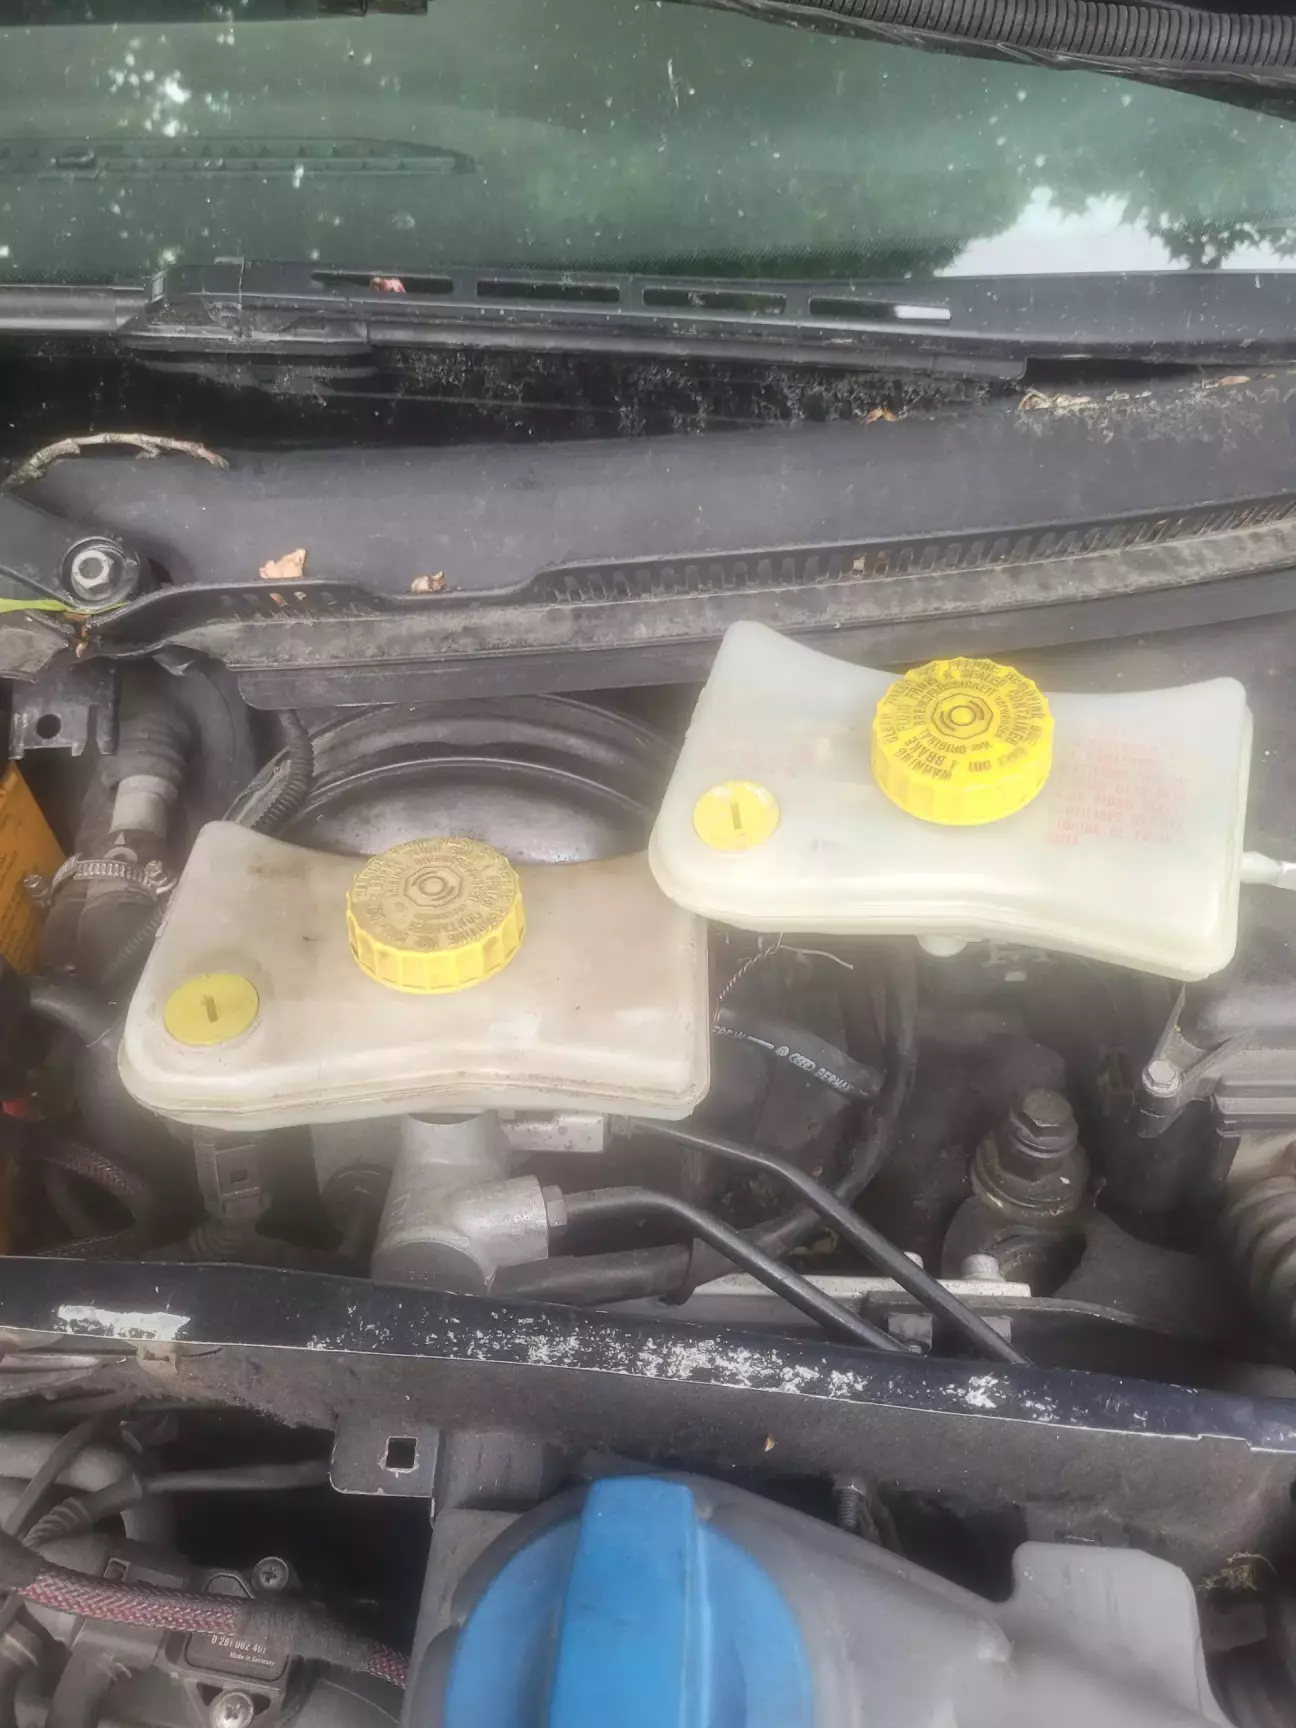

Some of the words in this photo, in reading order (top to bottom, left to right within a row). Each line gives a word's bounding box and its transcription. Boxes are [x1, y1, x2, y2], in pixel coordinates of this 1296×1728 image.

[904, 737, 946, 765] BRAKE
[219, 1636, 233, 1647] 281
[230, 1652, 245, 1660] Made
[252, 1657, 275, 1666] Germany
